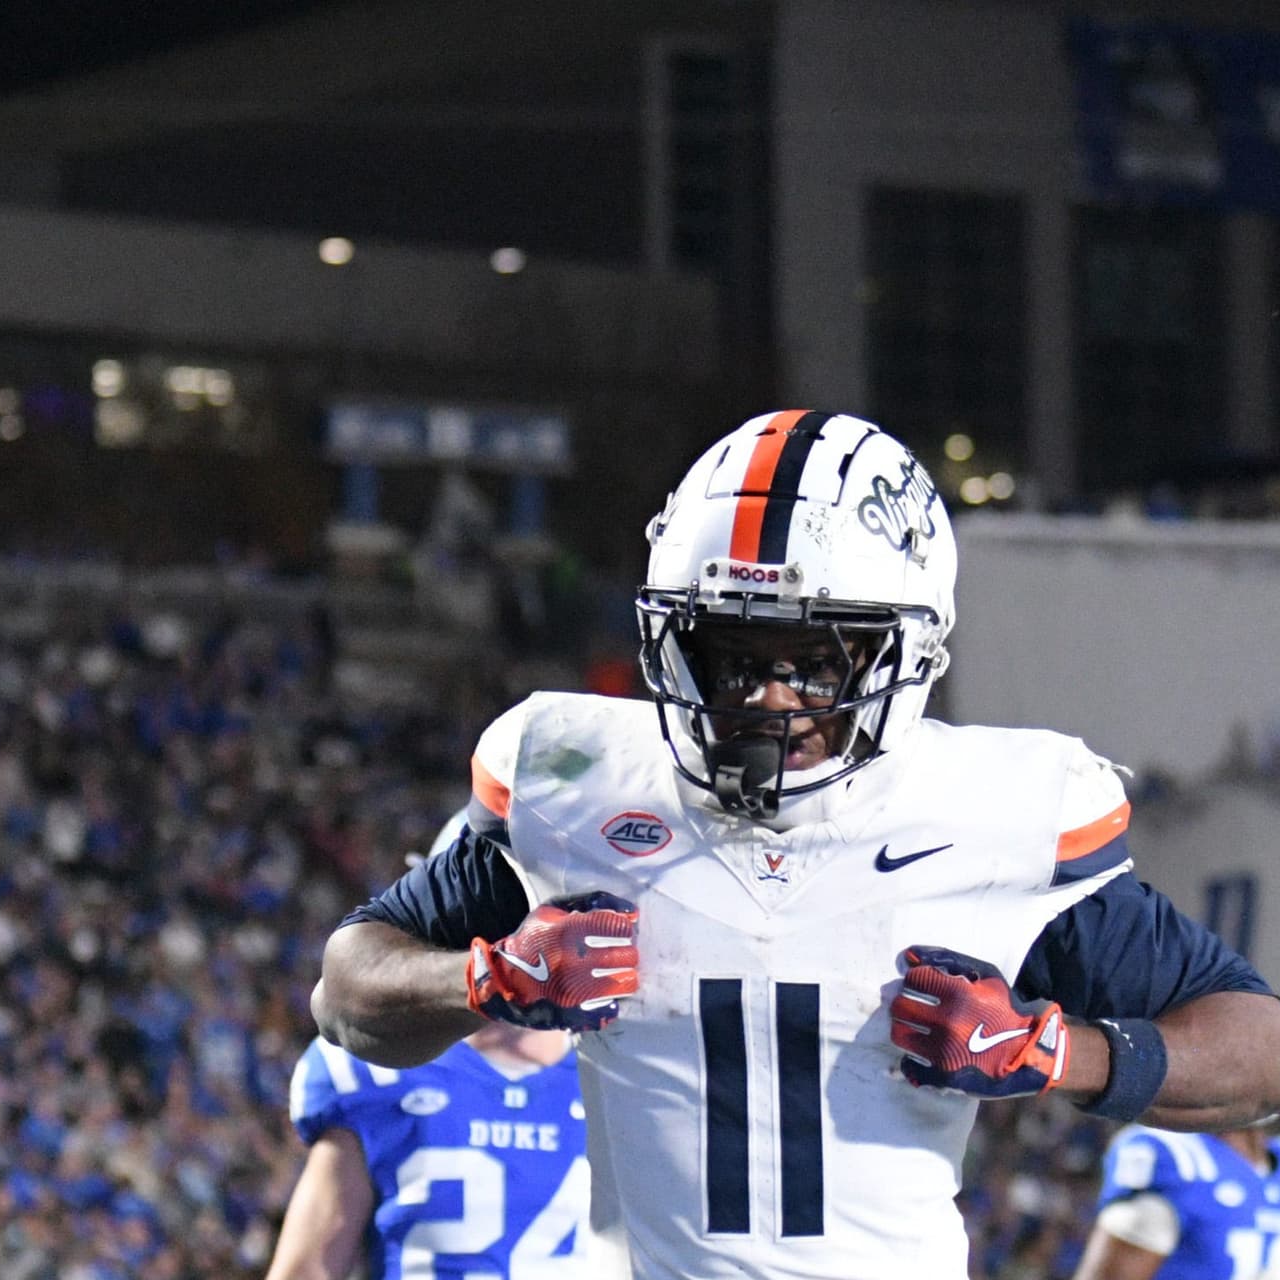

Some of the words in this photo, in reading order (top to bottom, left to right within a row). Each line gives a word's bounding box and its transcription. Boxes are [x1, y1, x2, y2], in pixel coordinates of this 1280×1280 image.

[728, 564, 780, 584] HOOS
[611, 821, 664, 841] ACC
[697, 976, 826, 1239] 11
[468, 1119, 560, 1151] DUKE
